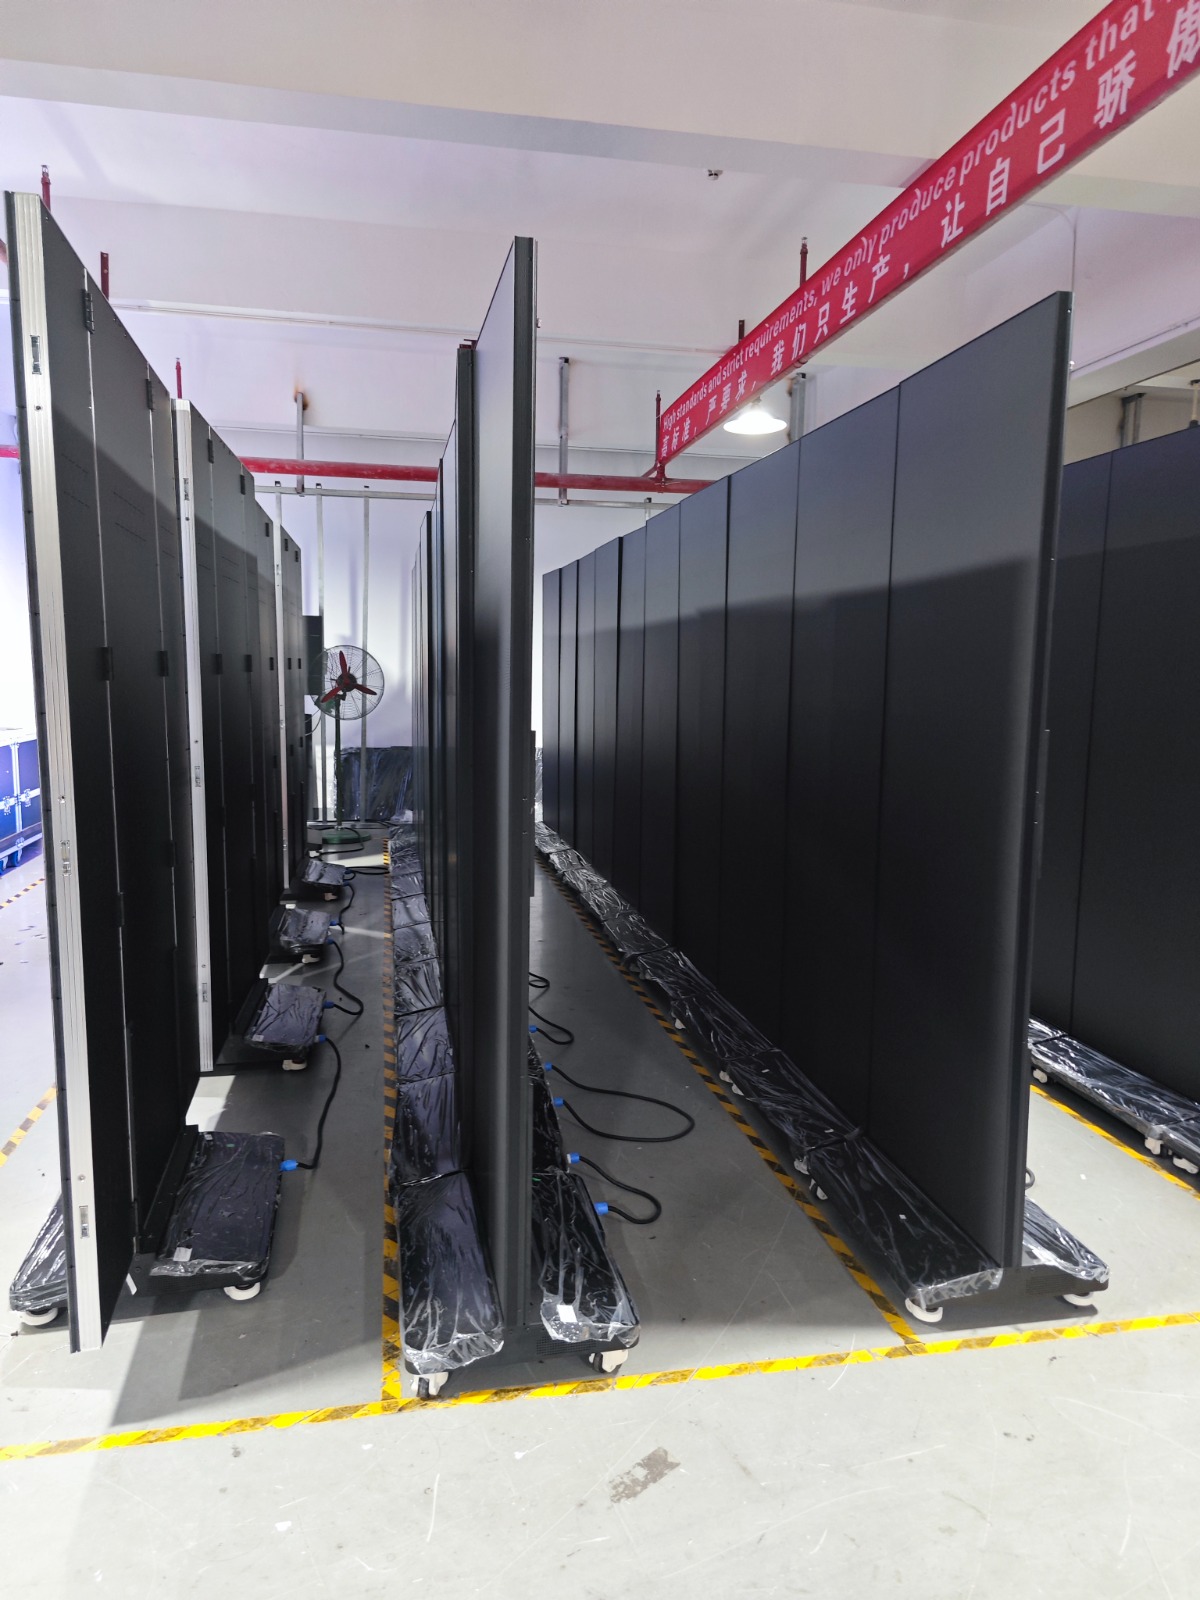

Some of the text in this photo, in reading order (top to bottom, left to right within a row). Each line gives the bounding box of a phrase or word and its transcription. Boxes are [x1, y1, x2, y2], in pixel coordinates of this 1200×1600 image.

[663, 0, 1155, 432] High standards and strict requirements, we only produce products that
